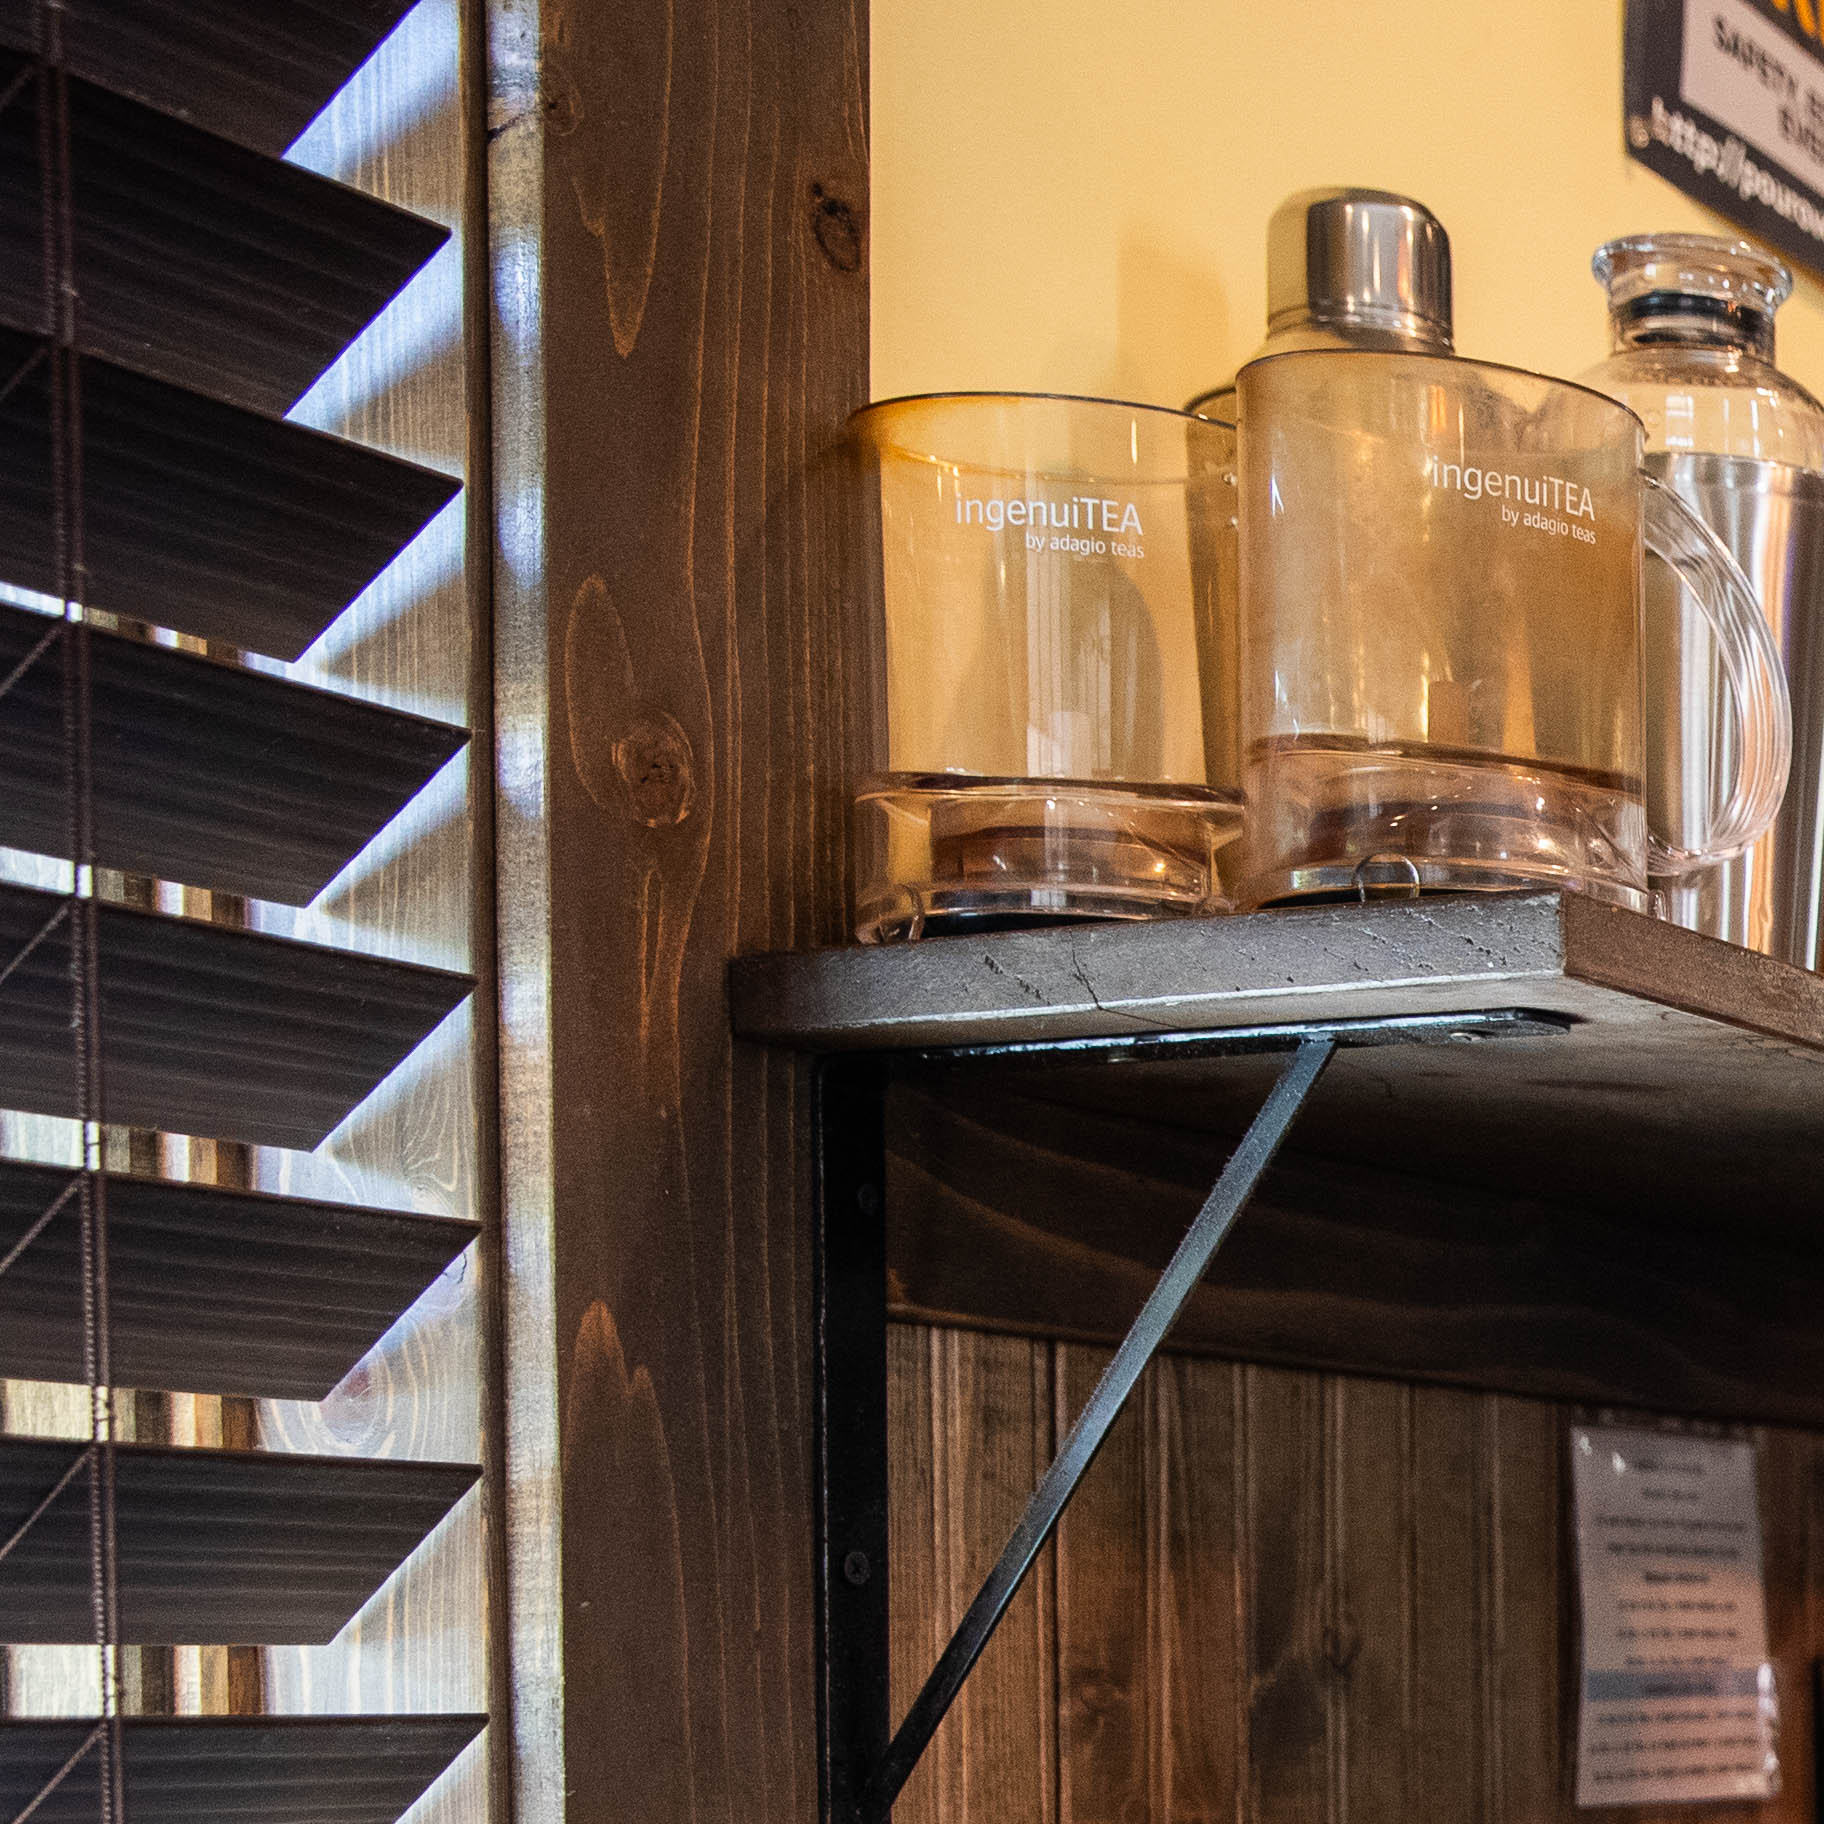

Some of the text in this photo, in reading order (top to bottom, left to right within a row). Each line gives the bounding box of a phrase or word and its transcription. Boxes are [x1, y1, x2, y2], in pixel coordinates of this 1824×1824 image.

[1432, 454, 1596, 522] ingenuiTEA
[955, 493, 1144, 536] ingenuiTEA
[1501, 504, 1597, 545] by adagio teas
[1025, 531, 1145, 559] by adagio teas
